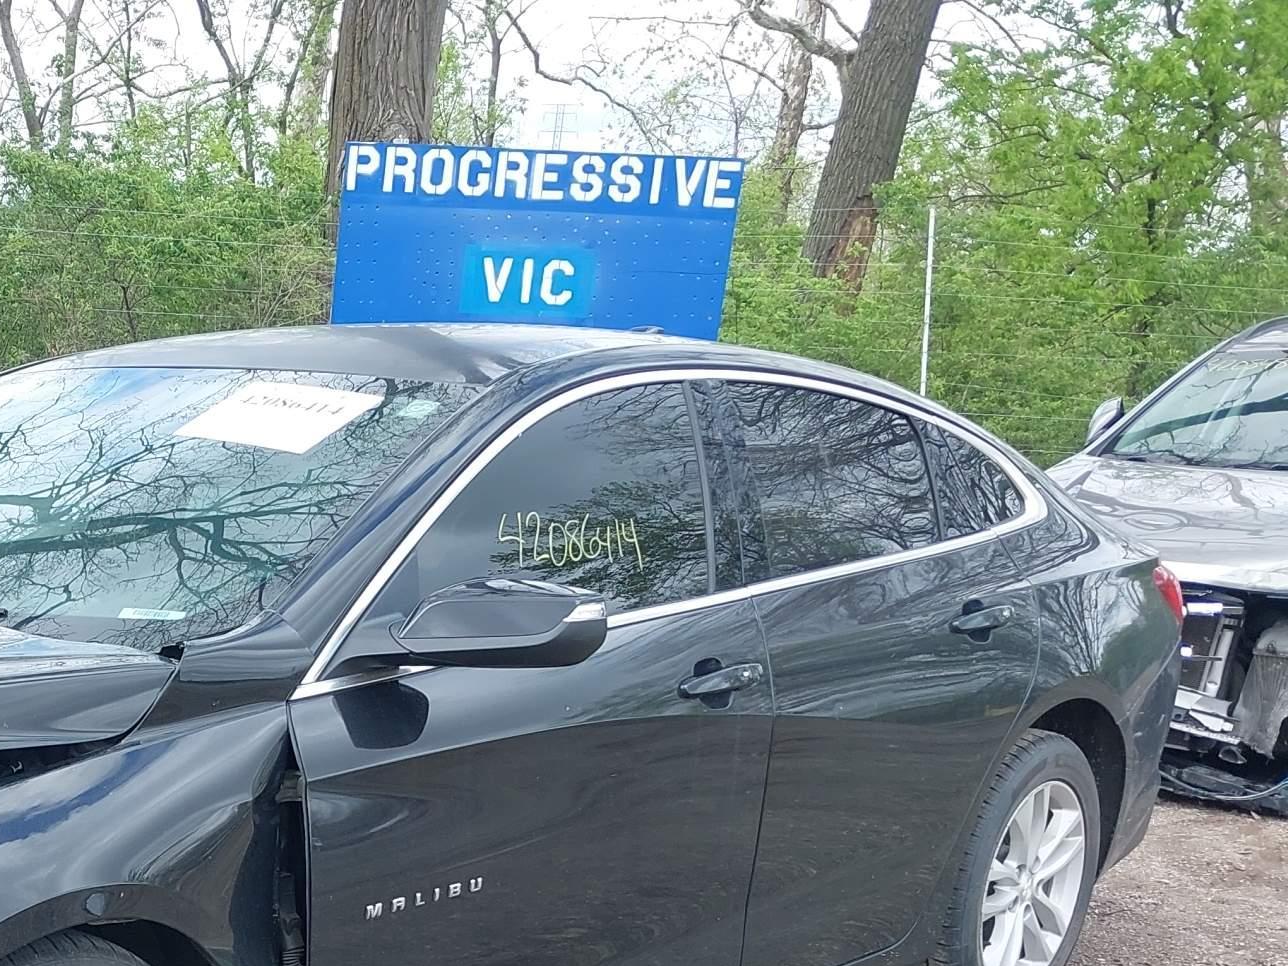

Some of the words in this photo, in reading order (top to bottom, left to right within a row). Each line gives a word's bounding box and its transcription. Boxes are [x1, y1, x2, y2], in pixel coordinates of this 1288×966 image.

[345, 143, 745, 209] PROGRESSIVE
[483, 256, 575, 306] VIC
[497, 511, 644, 572] 42086414
[365, 876, 484, 920] MALIBU
